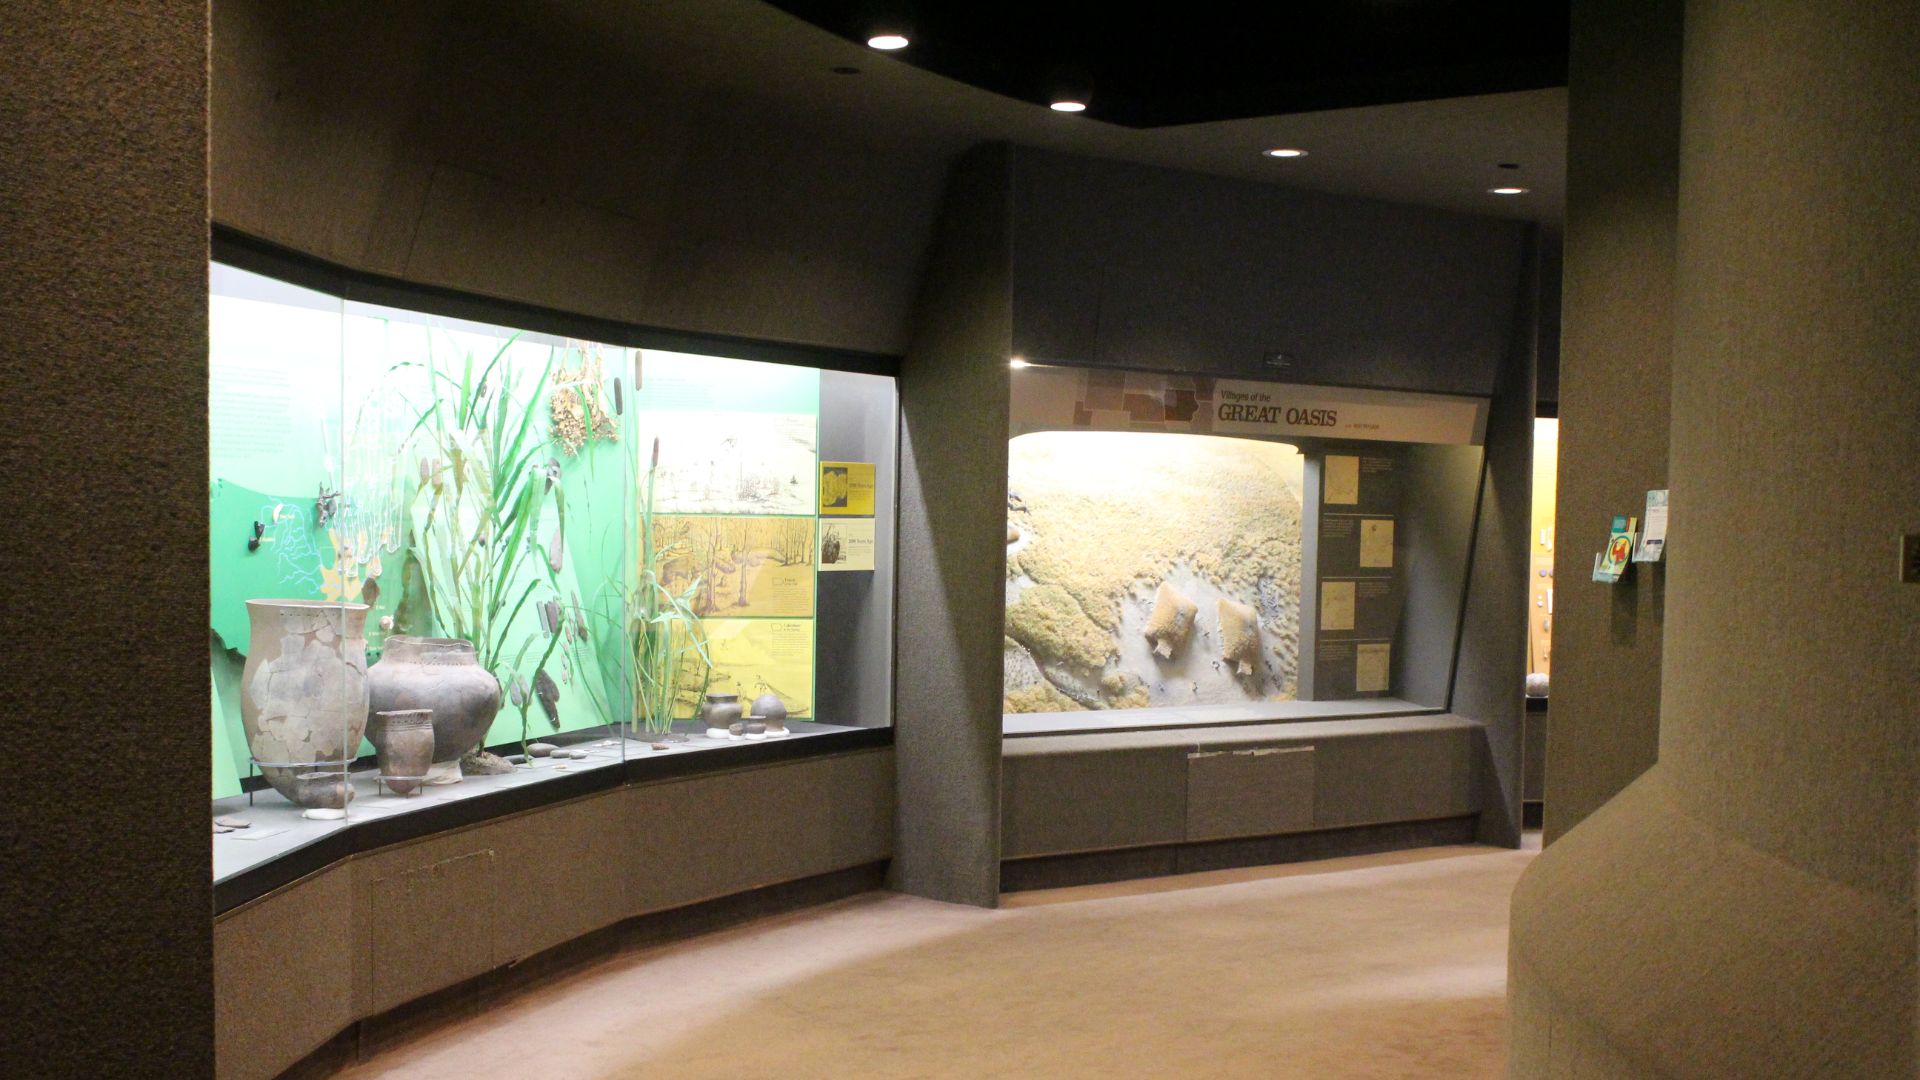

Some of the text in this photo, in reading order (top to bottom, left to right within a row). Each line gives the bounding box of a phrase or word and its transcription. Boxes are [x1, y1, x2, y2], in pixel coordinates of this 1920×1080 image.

[1221, 390, 1271, 402] Villages of the
[1218, 403, 1338, 427] GREAT OASIS
